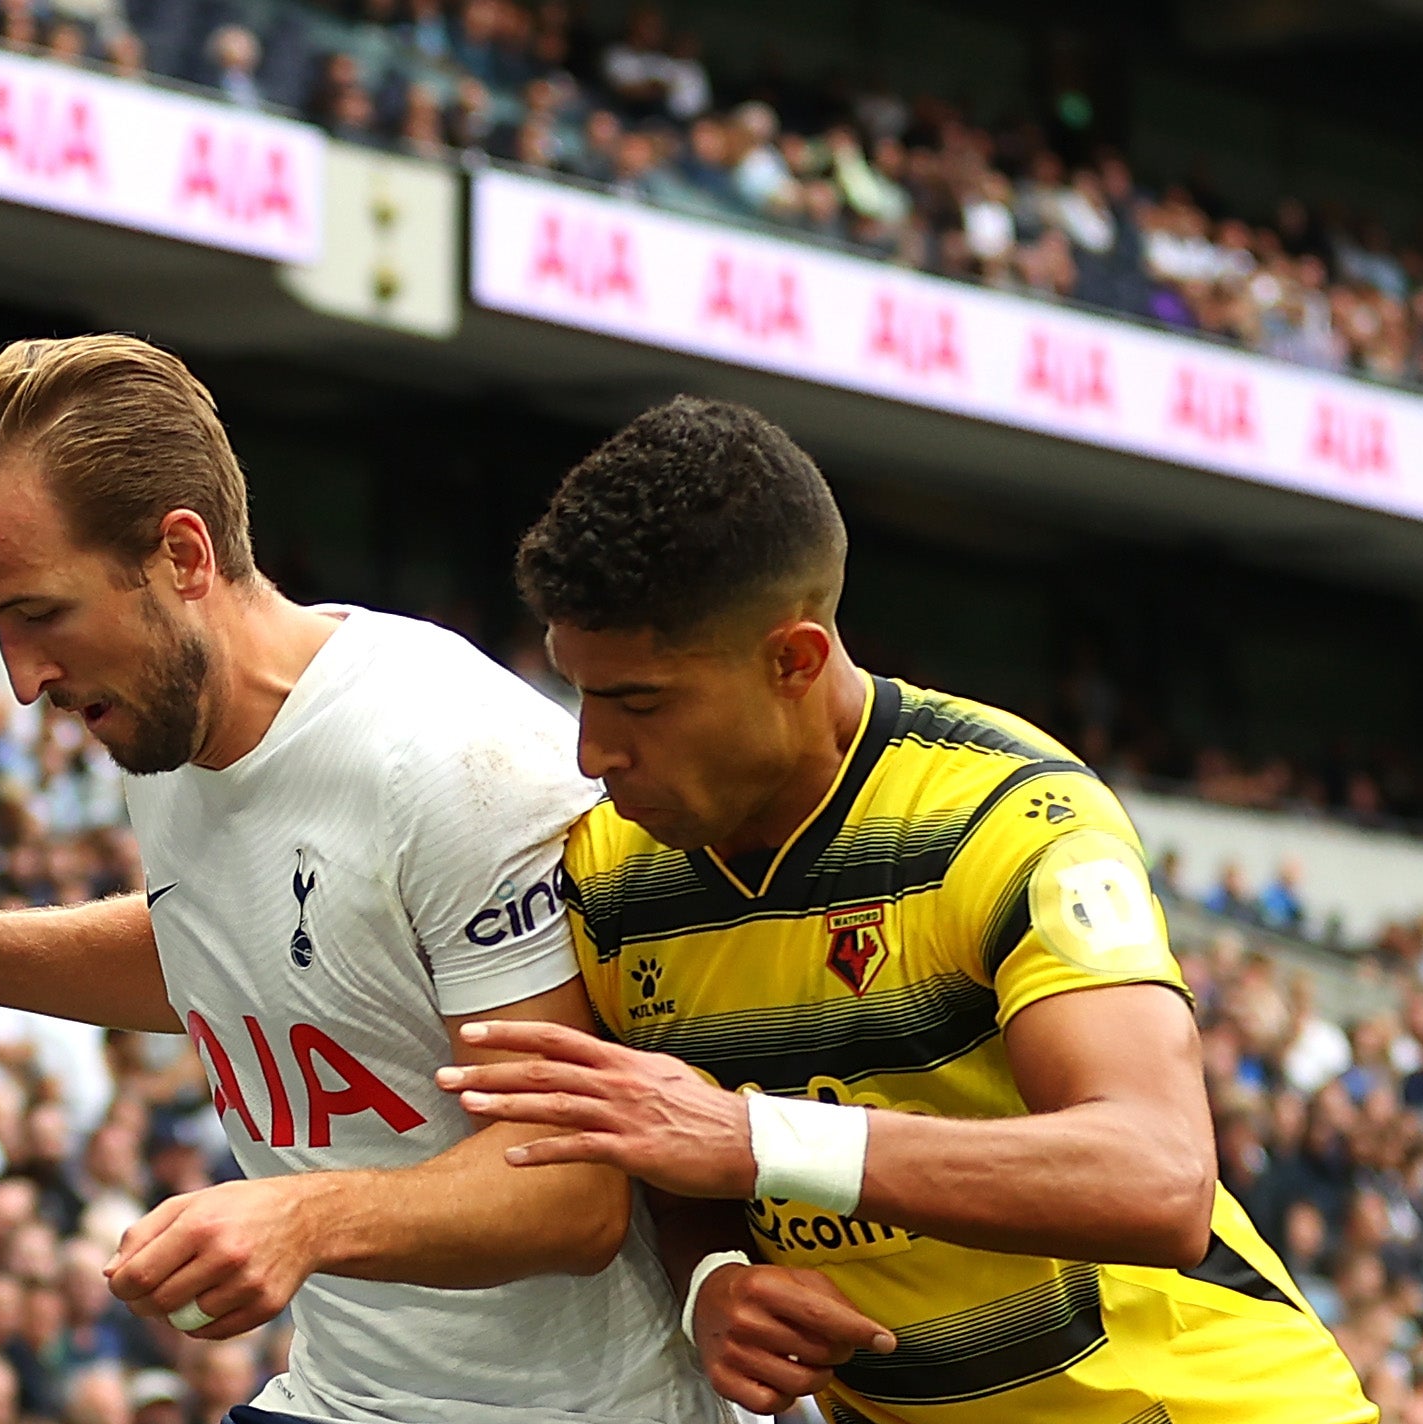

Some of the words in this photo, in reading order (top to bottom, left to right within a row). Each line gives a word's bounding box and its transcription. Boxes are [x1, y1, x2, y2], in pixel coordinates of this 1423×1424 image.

[172, 125, 305, 232] AIA
[525, 210, 645, 309] AIA
[697, 251, 812, 348] AIA
[861, 289, 969, 384] AIA
[1016, 327, 1119, 418] AIA
[1163, 362, 1263, 451] AIA
[465, 863, 564, 946] cin
[187, 1010, 427, 1149] AIA
